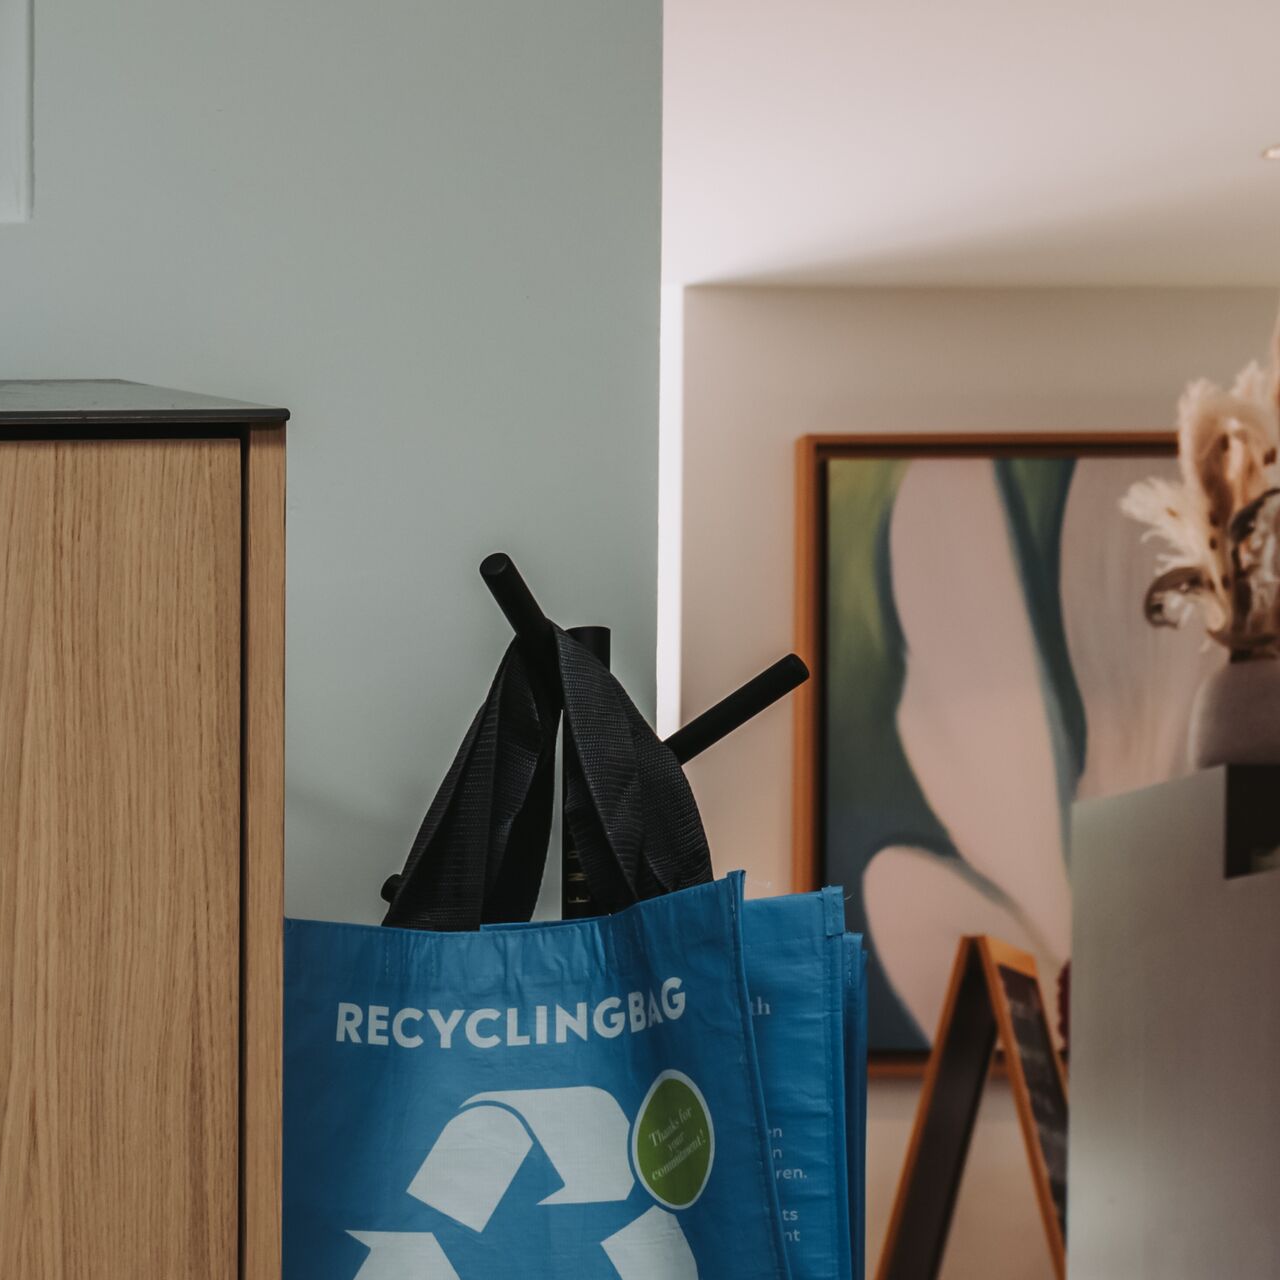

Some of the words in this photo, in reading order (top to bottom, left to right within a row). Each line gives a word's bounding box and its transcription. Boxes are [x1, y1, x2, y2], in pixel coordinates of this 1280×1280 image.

[335, 976, 686, 1049] RECYCLINGBAG
[648, 1116, 679, 1147] Thanks
[678, 1106, 692, 1124] for
[651, 1128, 707, 1181] commitment!
